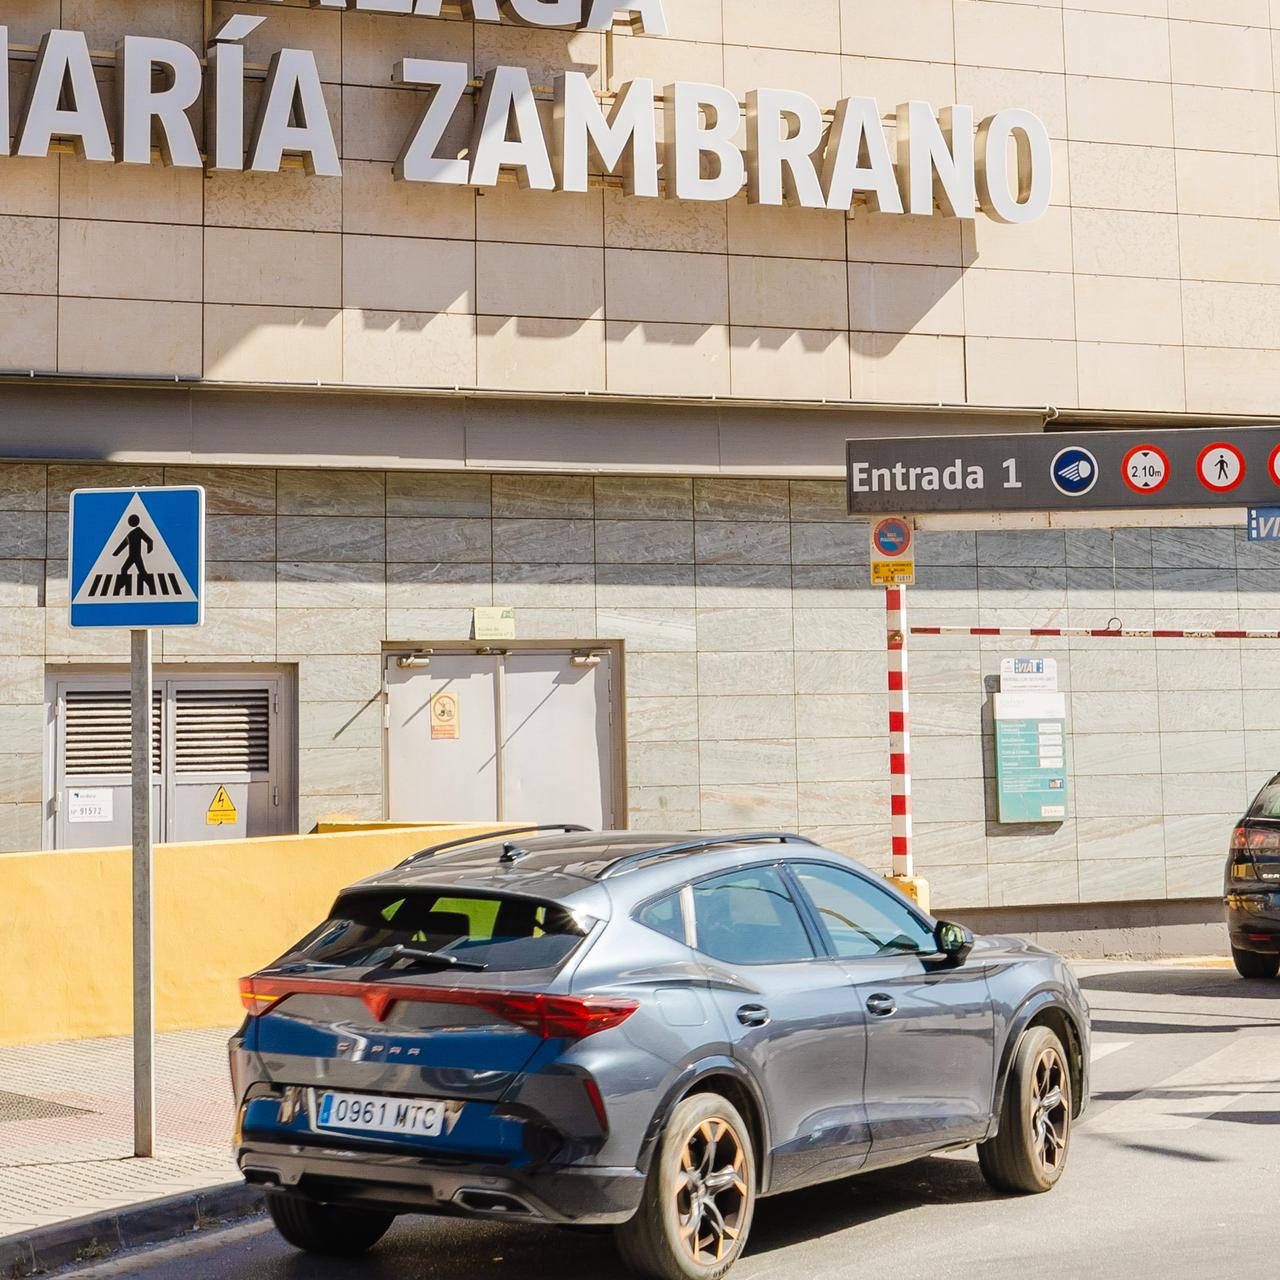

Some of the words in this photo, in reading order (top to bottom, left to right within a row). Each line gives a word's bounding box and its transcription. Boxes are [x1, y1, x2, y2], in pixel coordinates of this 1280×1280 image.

[391, 56, 1054, 226] ZAMBRANO
[852, 458, 985, 493] Entrada
[1002, 458, 1022, 489] 1
[336, 1099, 387, 1125] 0961
[393, 1104, 437, 1130] MTC
